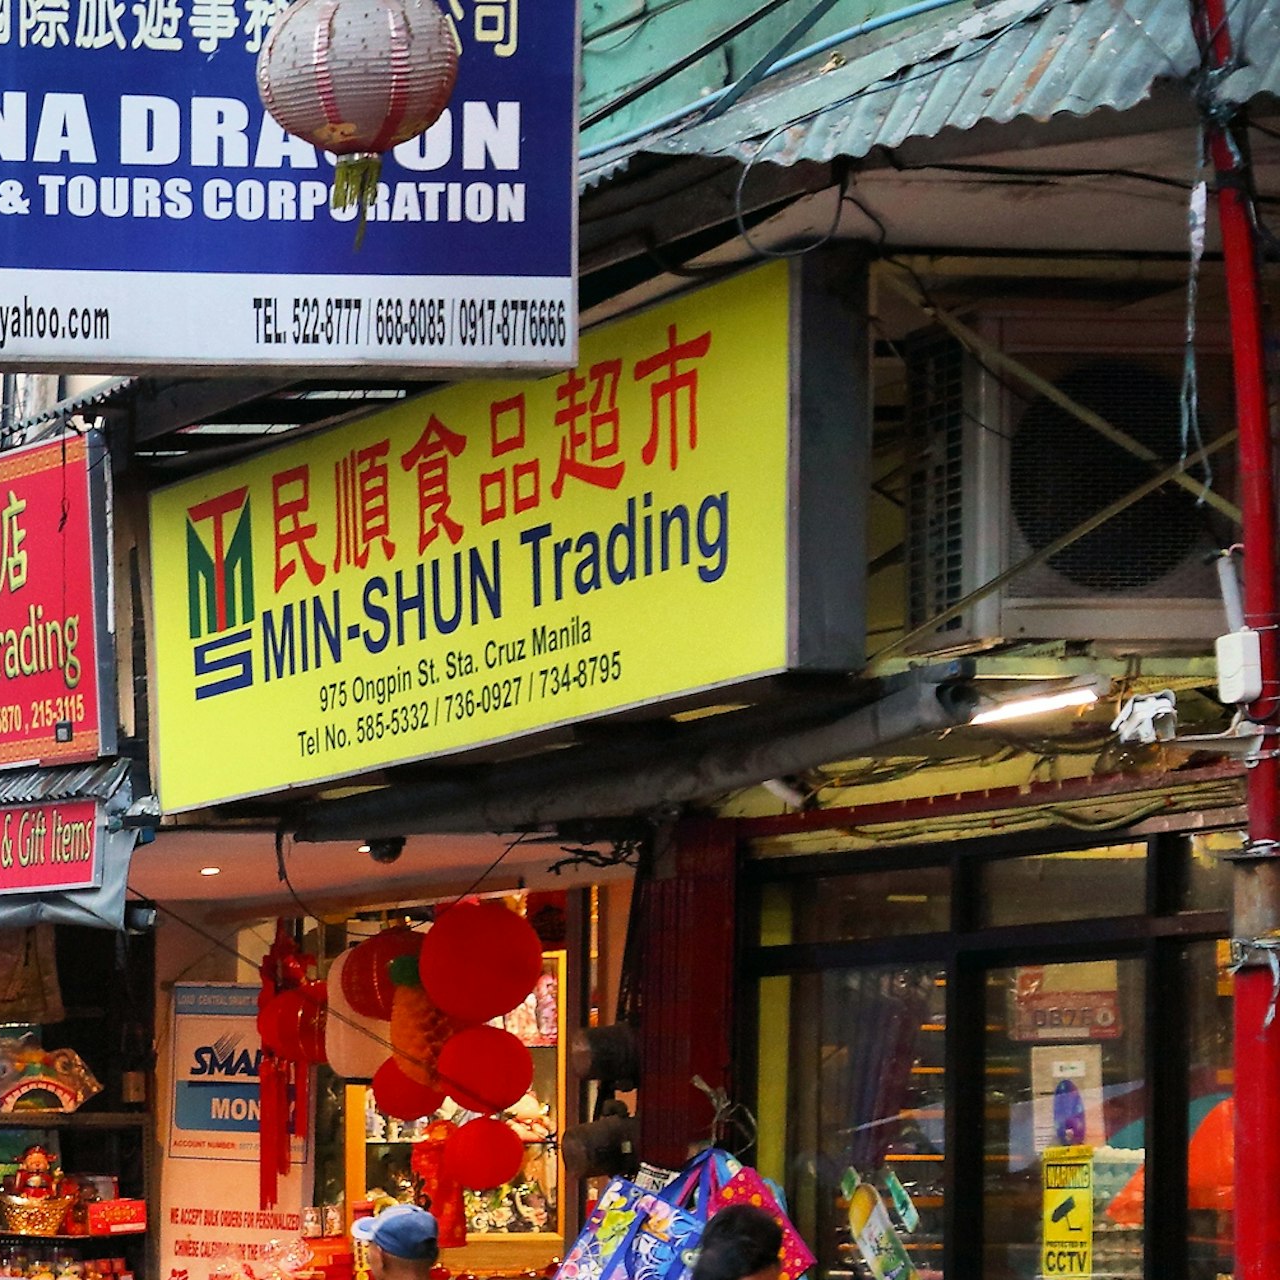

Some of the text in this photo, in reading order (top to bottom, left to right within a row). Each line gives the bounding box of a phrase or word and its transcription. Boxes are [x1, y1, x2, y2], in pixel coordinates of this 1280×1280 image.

[120, 94, 520, 171] DRAON
[39, 174, 192, 219] TOURS
[253, 298, 286, 344] TEL.
[293, 298, 362, 345] 522-8777
[376, 298, 445, 346] 668-8085
[459, 298, 566, 347] 0917-8776666
[262, 491, 729, 683] MIN-SHUN Trading
[320, 617, 592, 717] 975 Ongpin St. Sta. Cruz Manila
[298, 731, 321, 758] Tel
[325, 722, 352, 752] No.
[356, 707, 429, 746] 585-5332
[445, 684, 522, 725] 736-0927
[539, 651, 622, 699] 734-8795
[1, 813, 14, 866] &
[18, 810, 47, 866] Gift
[50, 810, 94, 863] Items
[1047, 1165, 1089, 1188] WARNING
[180, 1208, 202, 1226] ACCEPT
[1046, 1251, 1088, 1273] CCTV
